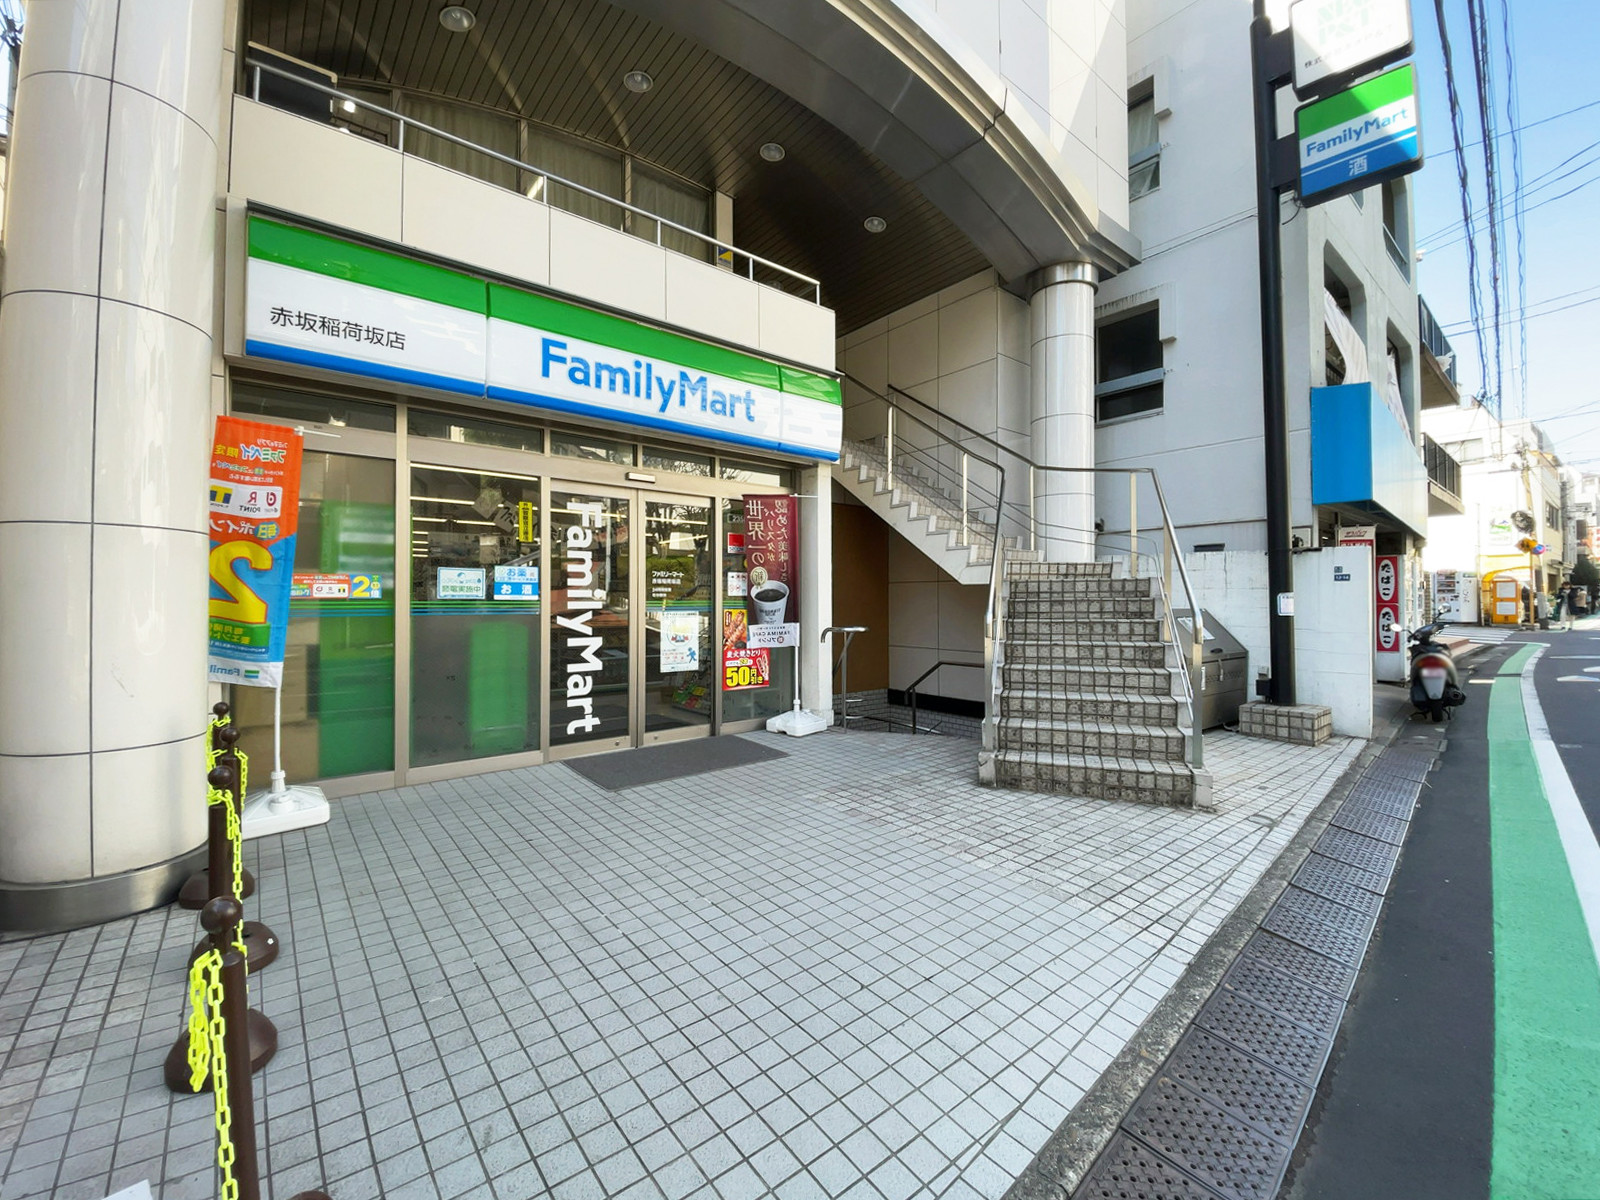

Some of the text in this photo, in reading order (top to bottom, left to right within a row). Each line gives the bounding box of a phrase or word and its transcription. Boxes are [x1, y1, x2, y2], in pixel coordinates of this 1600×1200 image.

[1306, 108, 1408, 157] FamilyMart
[1349, 155, 1368, 177] 酒
[270, 307, 406, 351] 赤坂稲荷坂店
[540, 337, 756, 422] FamilyMart
[1380, 563, 1393, 596] たばこ
[557, 501, 603, 735] FamilyMart
